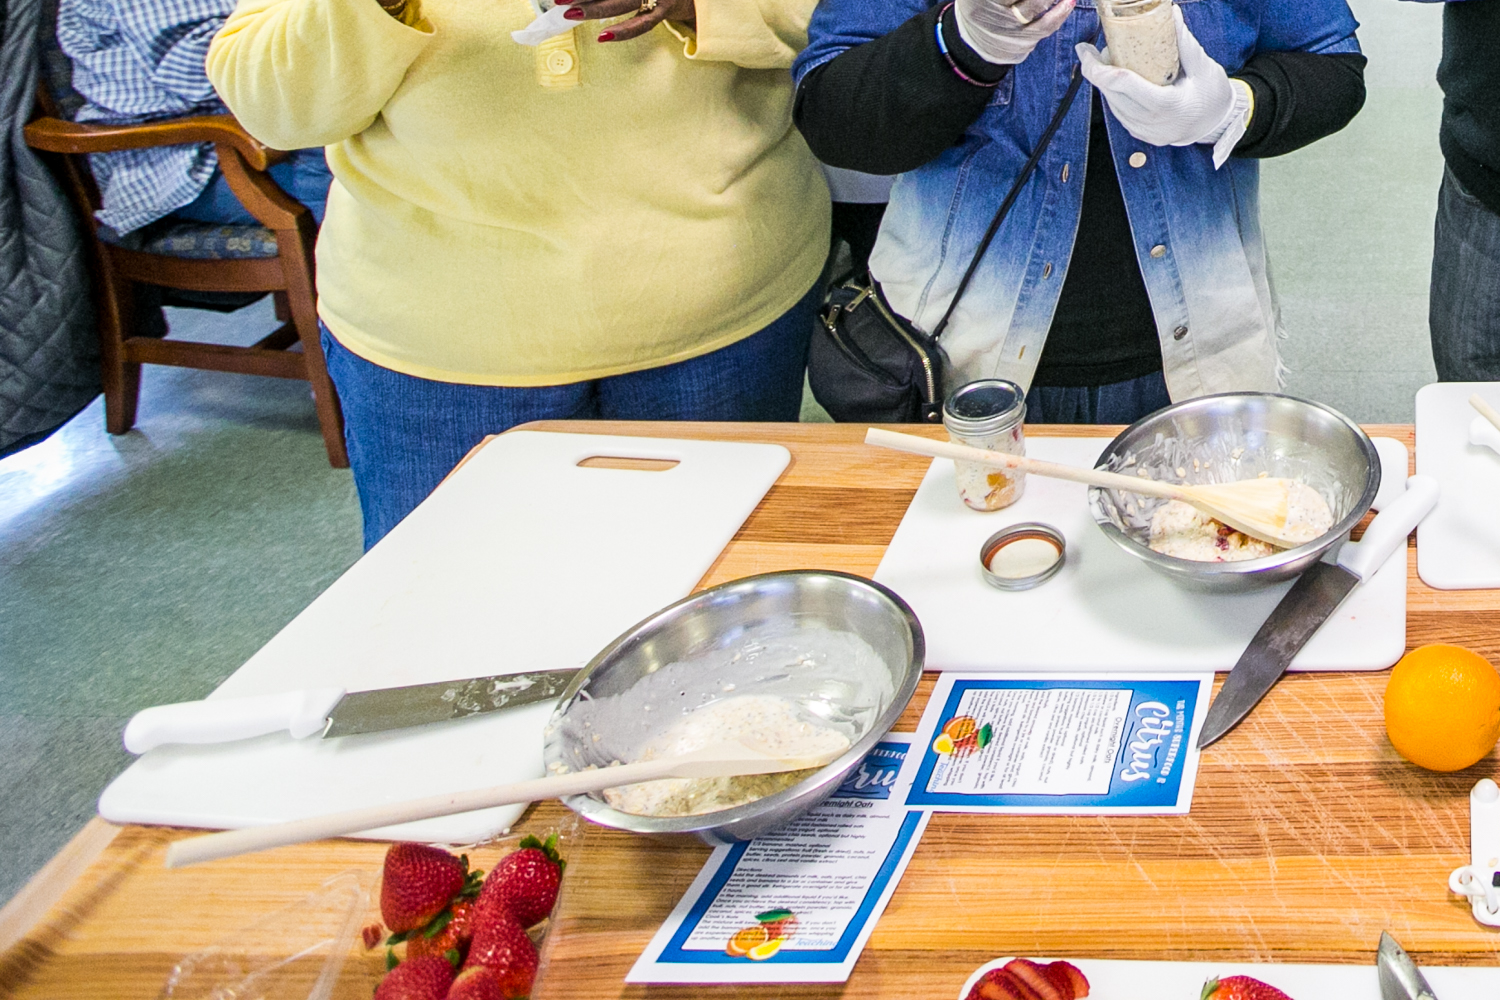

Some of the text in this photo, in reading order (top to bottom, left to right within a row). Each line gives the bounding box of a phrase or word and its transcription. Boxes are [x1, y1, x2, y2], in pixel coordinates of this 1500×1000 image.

[1109, 716, 1122, 747] Overnight
[1120, 702, 1172, 781] Citrus
[1104, 748, 1114, 763] Oats
